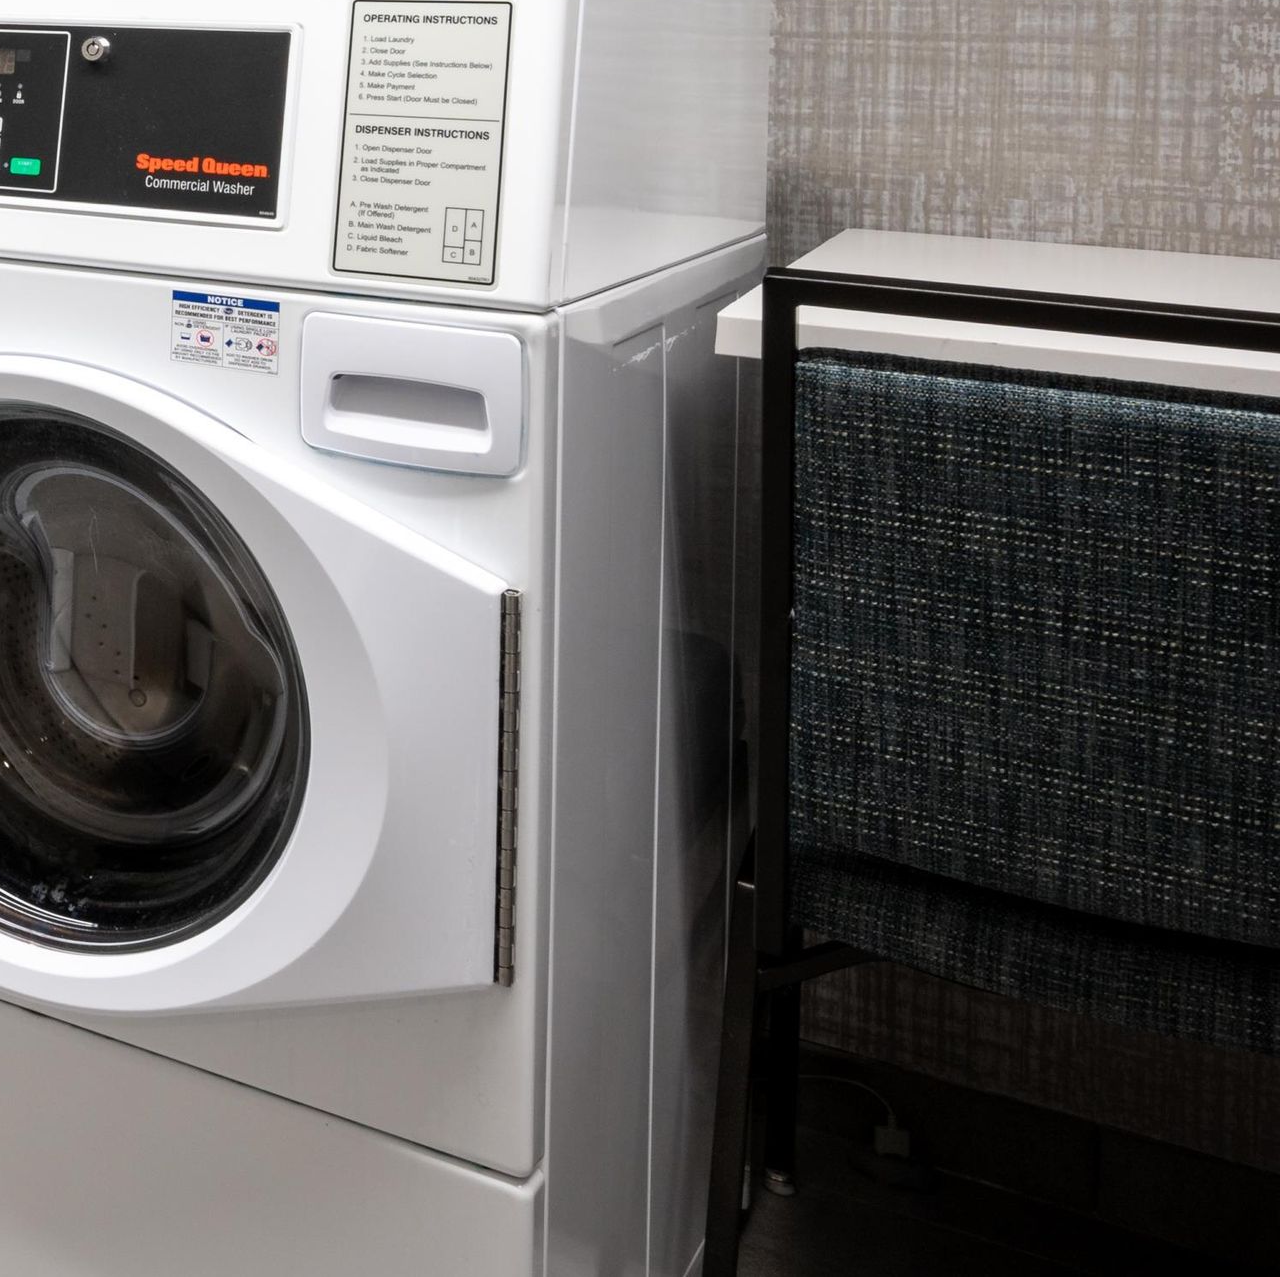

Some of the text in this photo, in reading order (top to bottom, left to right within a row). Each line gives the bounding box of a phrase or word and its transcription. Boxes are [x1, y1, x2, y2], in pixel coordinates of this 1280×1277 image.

[363, 14, 498, 25] OPERATING INSTRUCTIONS
[355, 125, 490, 140] DISPENSER INSTRUCTIONS
[136, 153, 268, 178] Speed Queen
[145, 175, 255, 195] Commercial Washer
[207, 295, 244, 307] NOTICE
